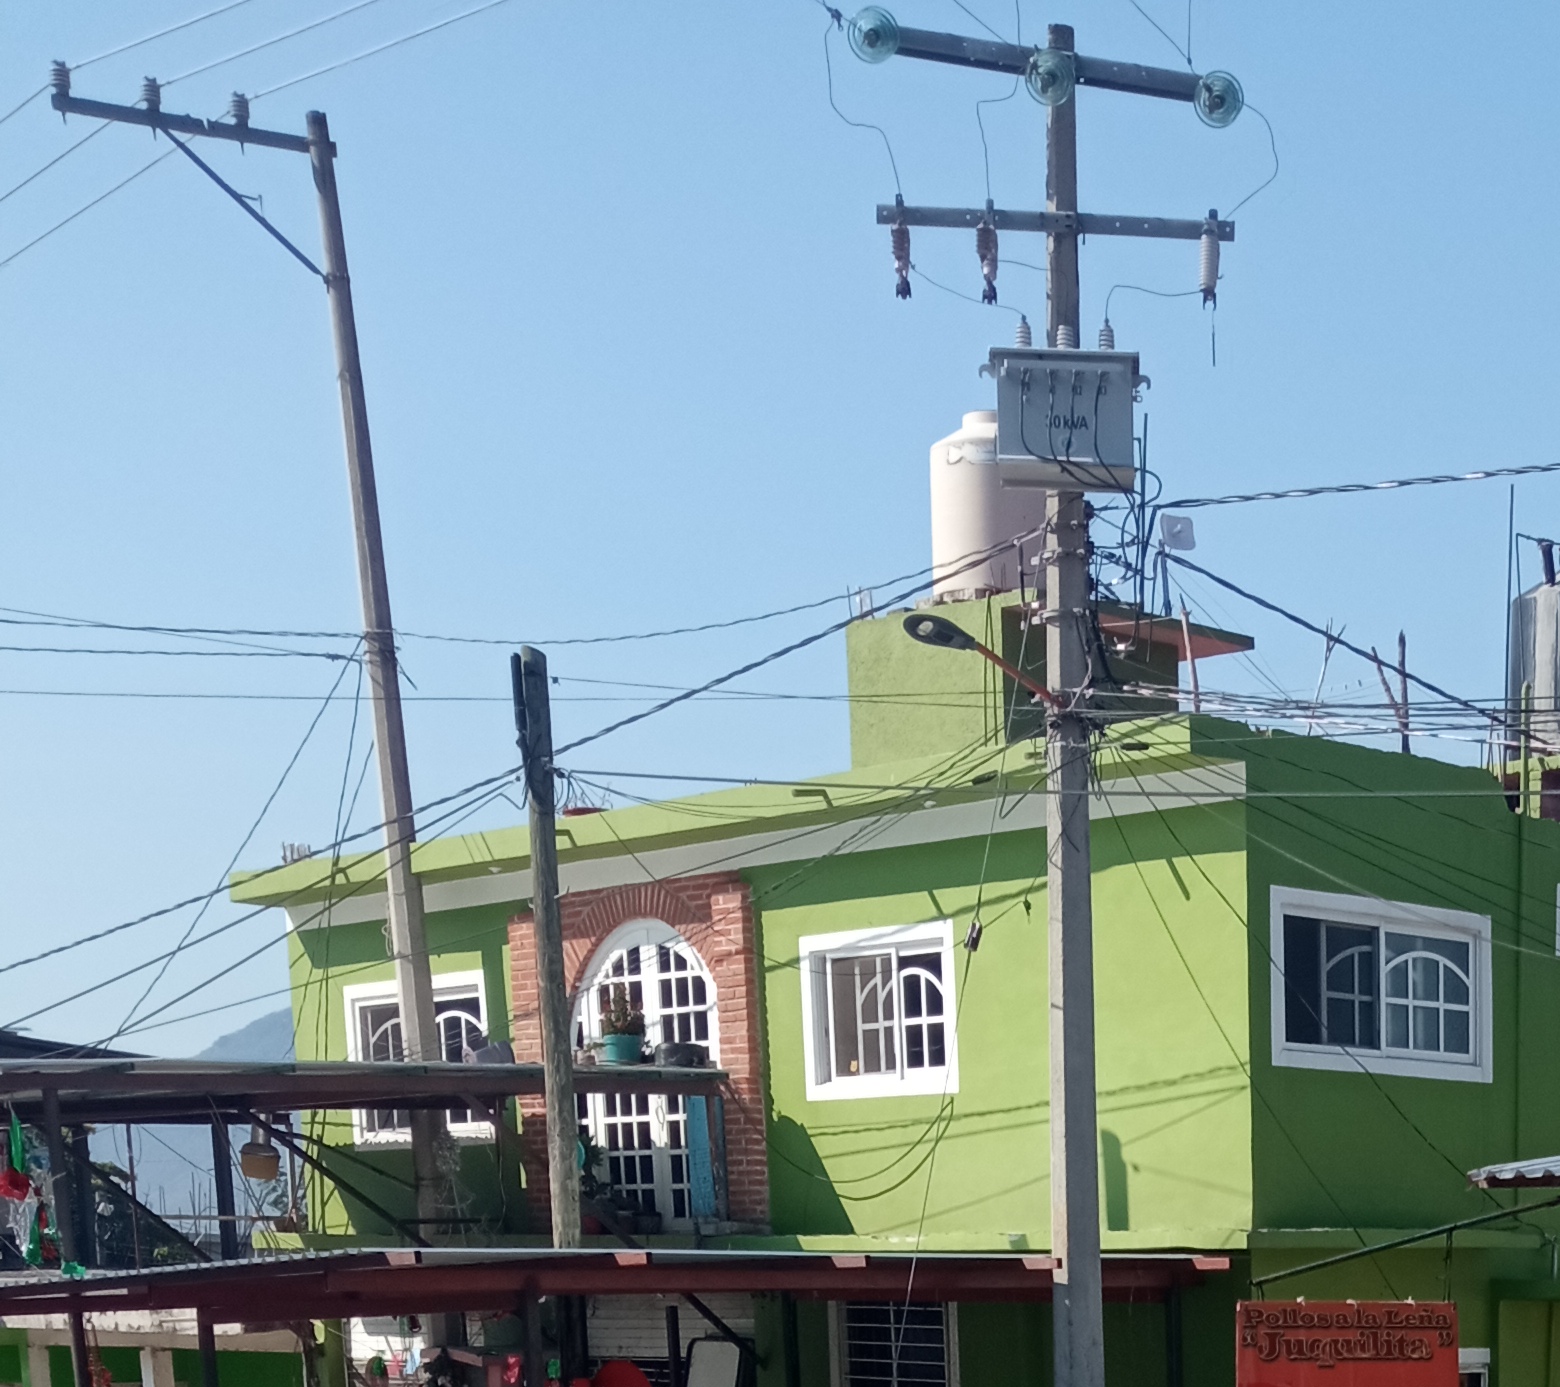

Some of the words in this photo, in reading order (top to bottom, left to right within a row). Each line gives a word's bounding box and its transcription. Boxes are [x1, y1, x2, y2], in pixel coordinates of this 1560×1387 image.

[1244, 1307, 1331, 1328] Pollos
[1334, 1312, 1352, 1328] a
[1354, 1308, 1381, 1328] la
[1383, 1306, 1452, 1328] Leña
